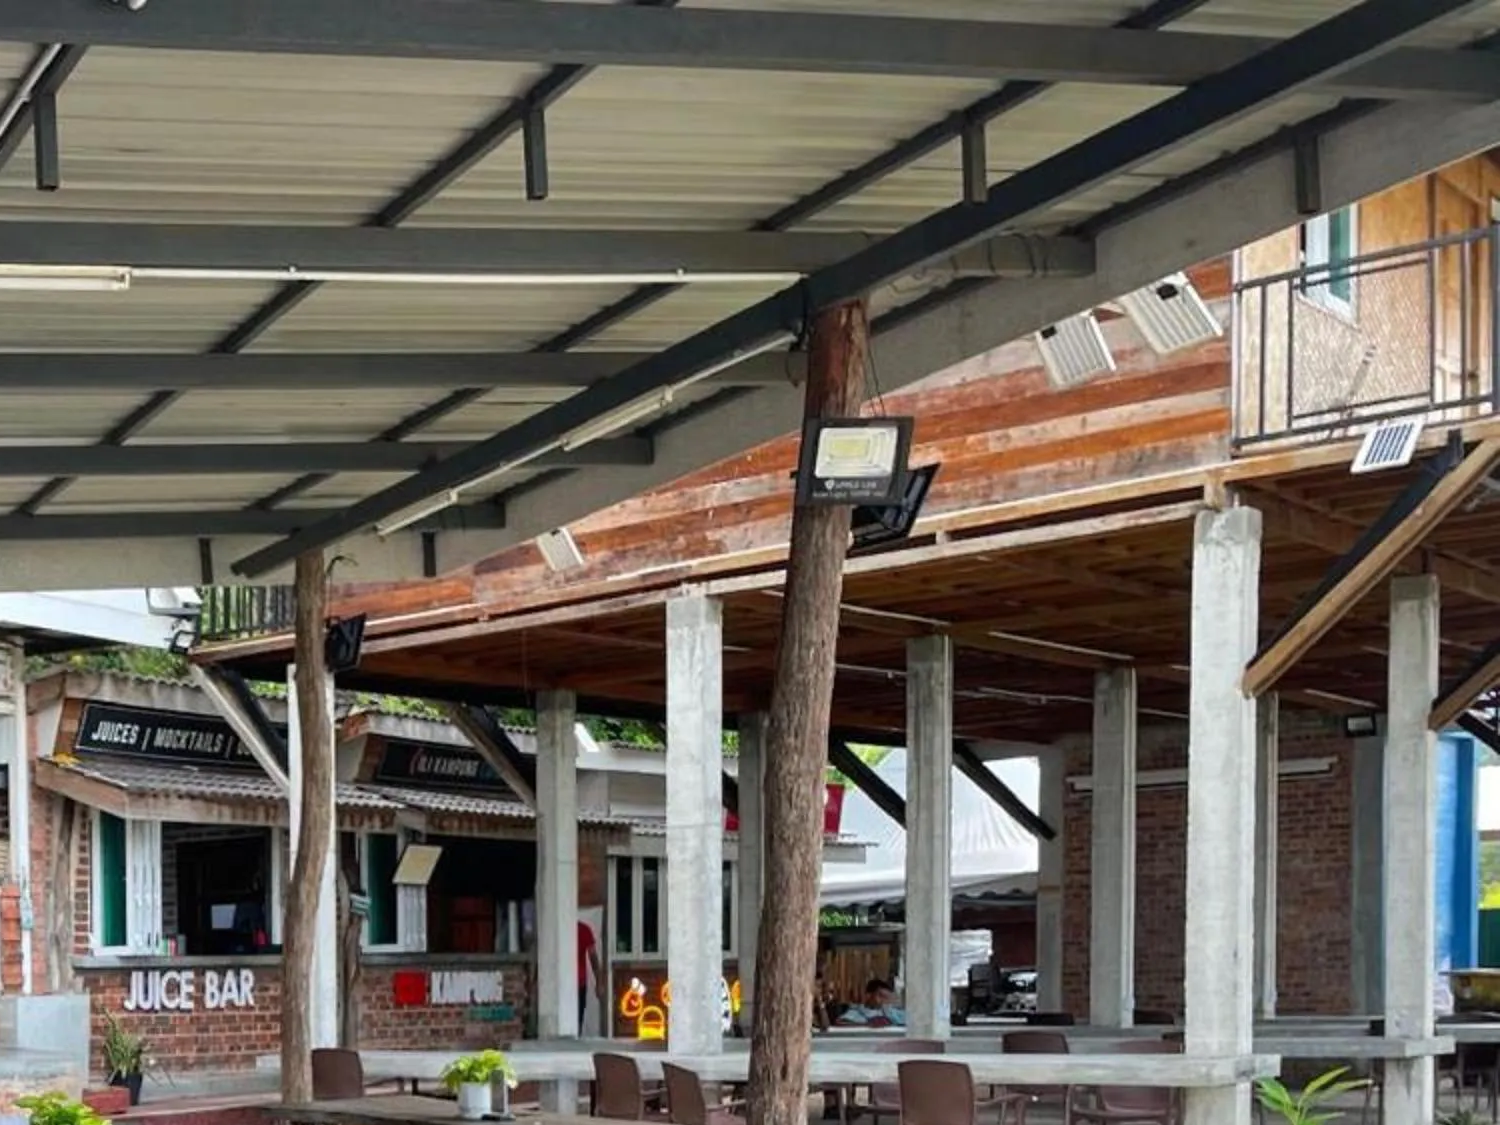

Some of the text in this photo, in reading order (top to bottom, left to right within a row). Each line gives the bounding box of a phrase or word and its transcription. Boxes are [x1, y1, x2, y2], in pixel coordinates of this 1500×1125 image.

[91, 721, 140, 745] JUICES
[153, 727, 225, 753] MOCKTAILS
[123, 969, 255, 1011] JUICE BAR
